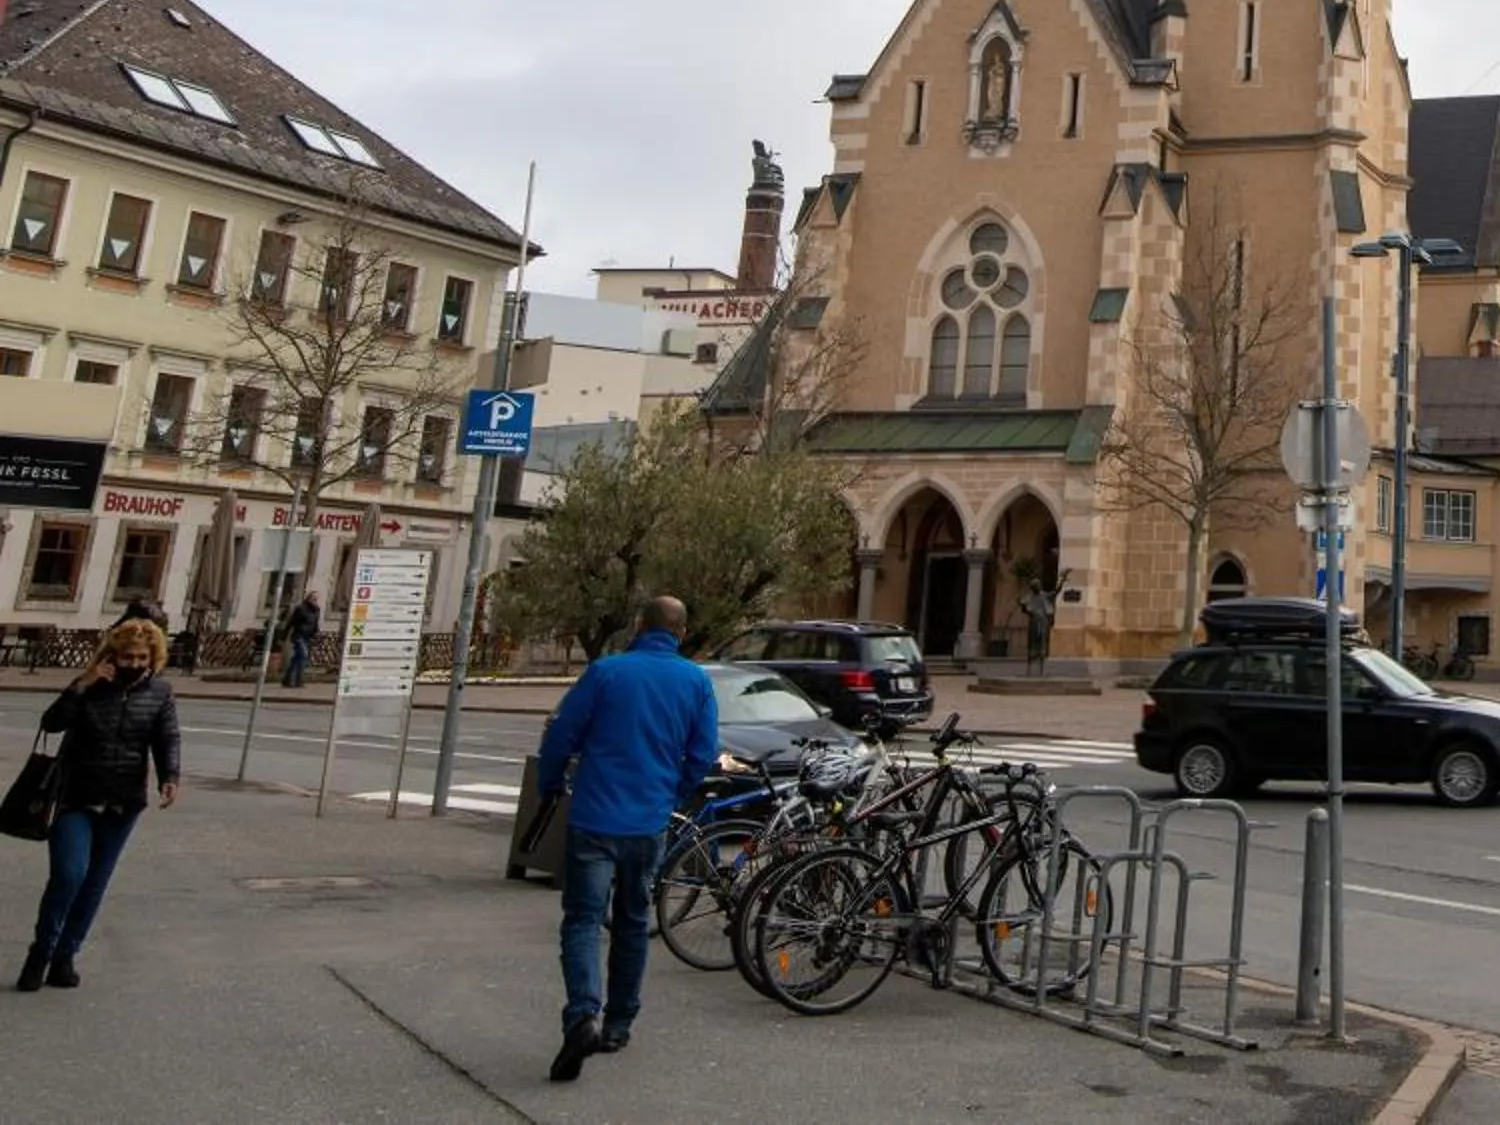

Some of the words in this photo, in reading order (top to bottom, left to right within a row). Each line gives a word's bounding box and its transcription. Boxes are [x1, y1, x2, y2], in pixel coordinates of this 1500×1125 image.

[490, 400, 516, 429] P
[21, 466, 72, 481] FESSL
[104, 491, 184, 517] BRAUHOF
